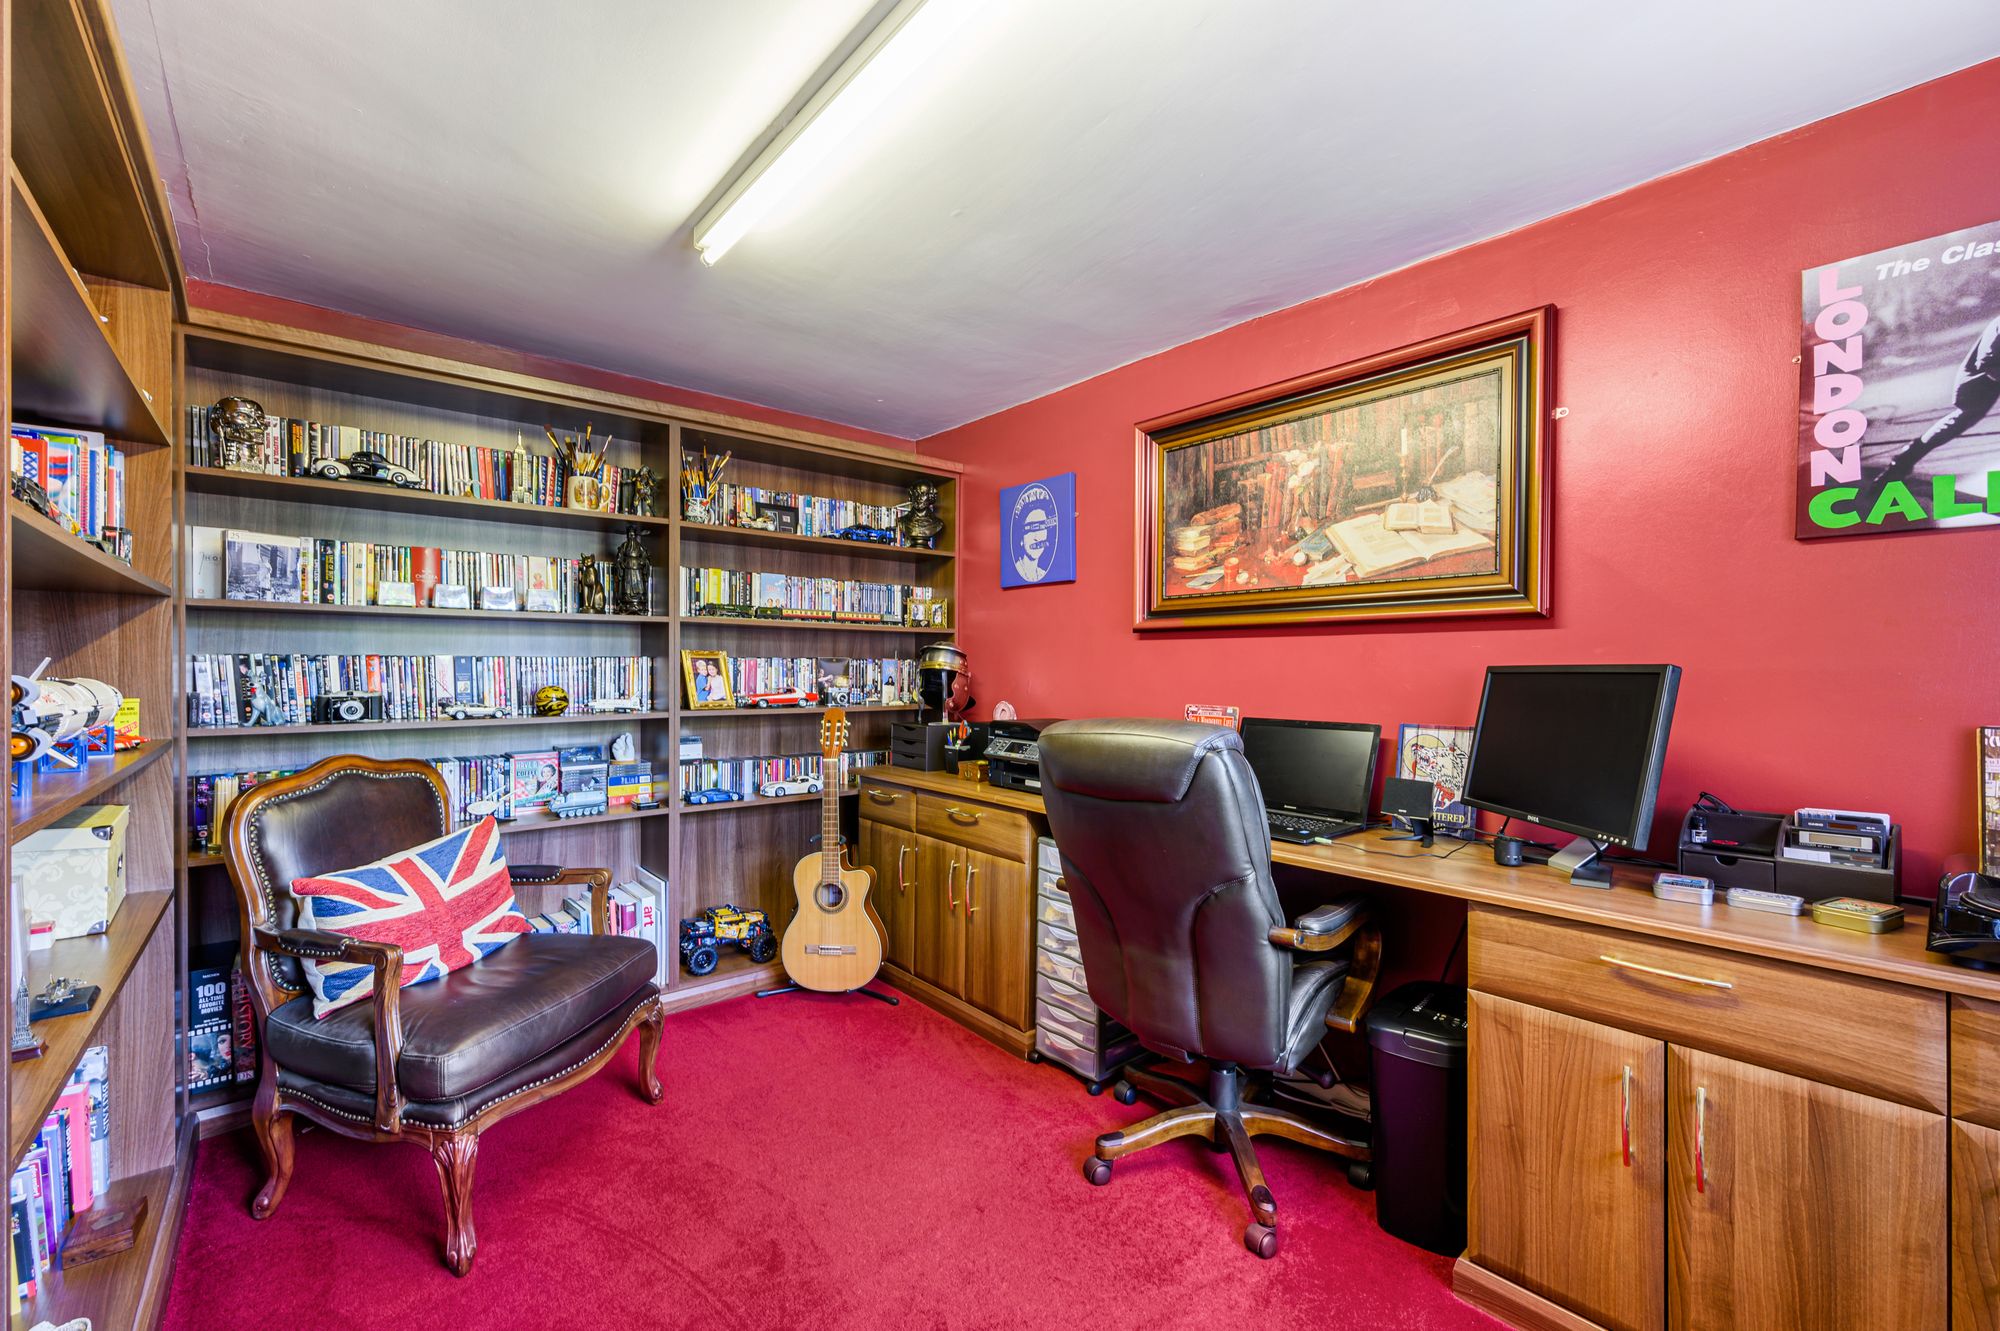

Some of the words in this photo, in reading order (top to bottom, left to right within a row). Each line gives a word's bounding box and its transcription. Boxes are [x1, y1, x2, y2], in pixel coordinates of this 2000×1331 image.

[1875, 257, 1930, 281] The
[1810, 267, 1868, 487] LONDON
[1808, 469, 2000, 529] CAL
[643, 905, 654, 927] art
[196, 982, 226, 998] 100
[237, 987, 252, 1049] HISTORY
